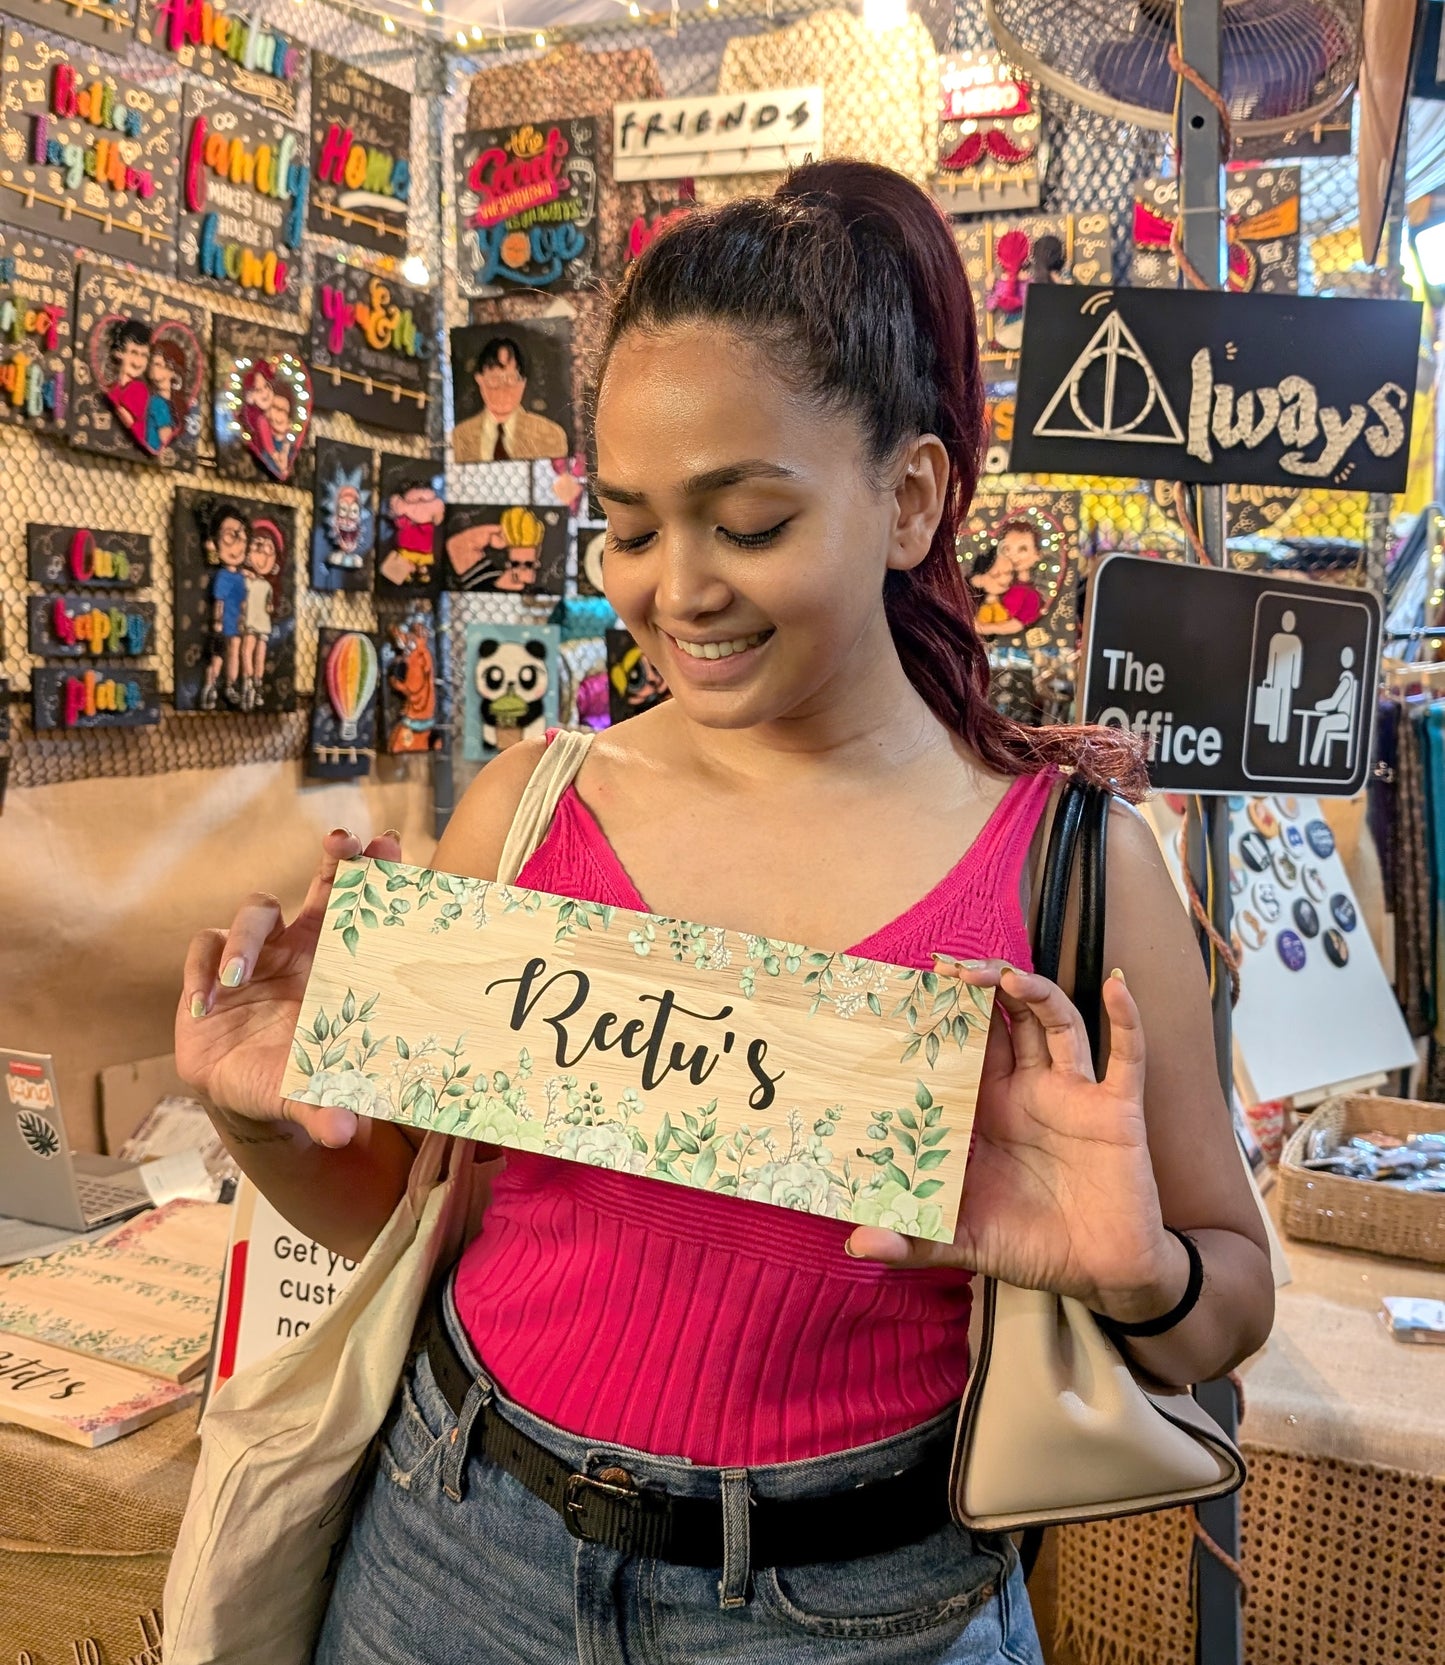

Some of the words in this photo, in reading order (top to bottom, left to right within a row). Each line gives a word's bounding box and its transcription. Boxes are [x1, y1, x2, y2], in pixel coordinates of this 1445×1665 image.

[54, 597, 150, 655] happy
[1102, 649, 1165, 695] The
[485, 957, 786, 1111] Reetu's
[273, 1235, 319, 1266] Get
